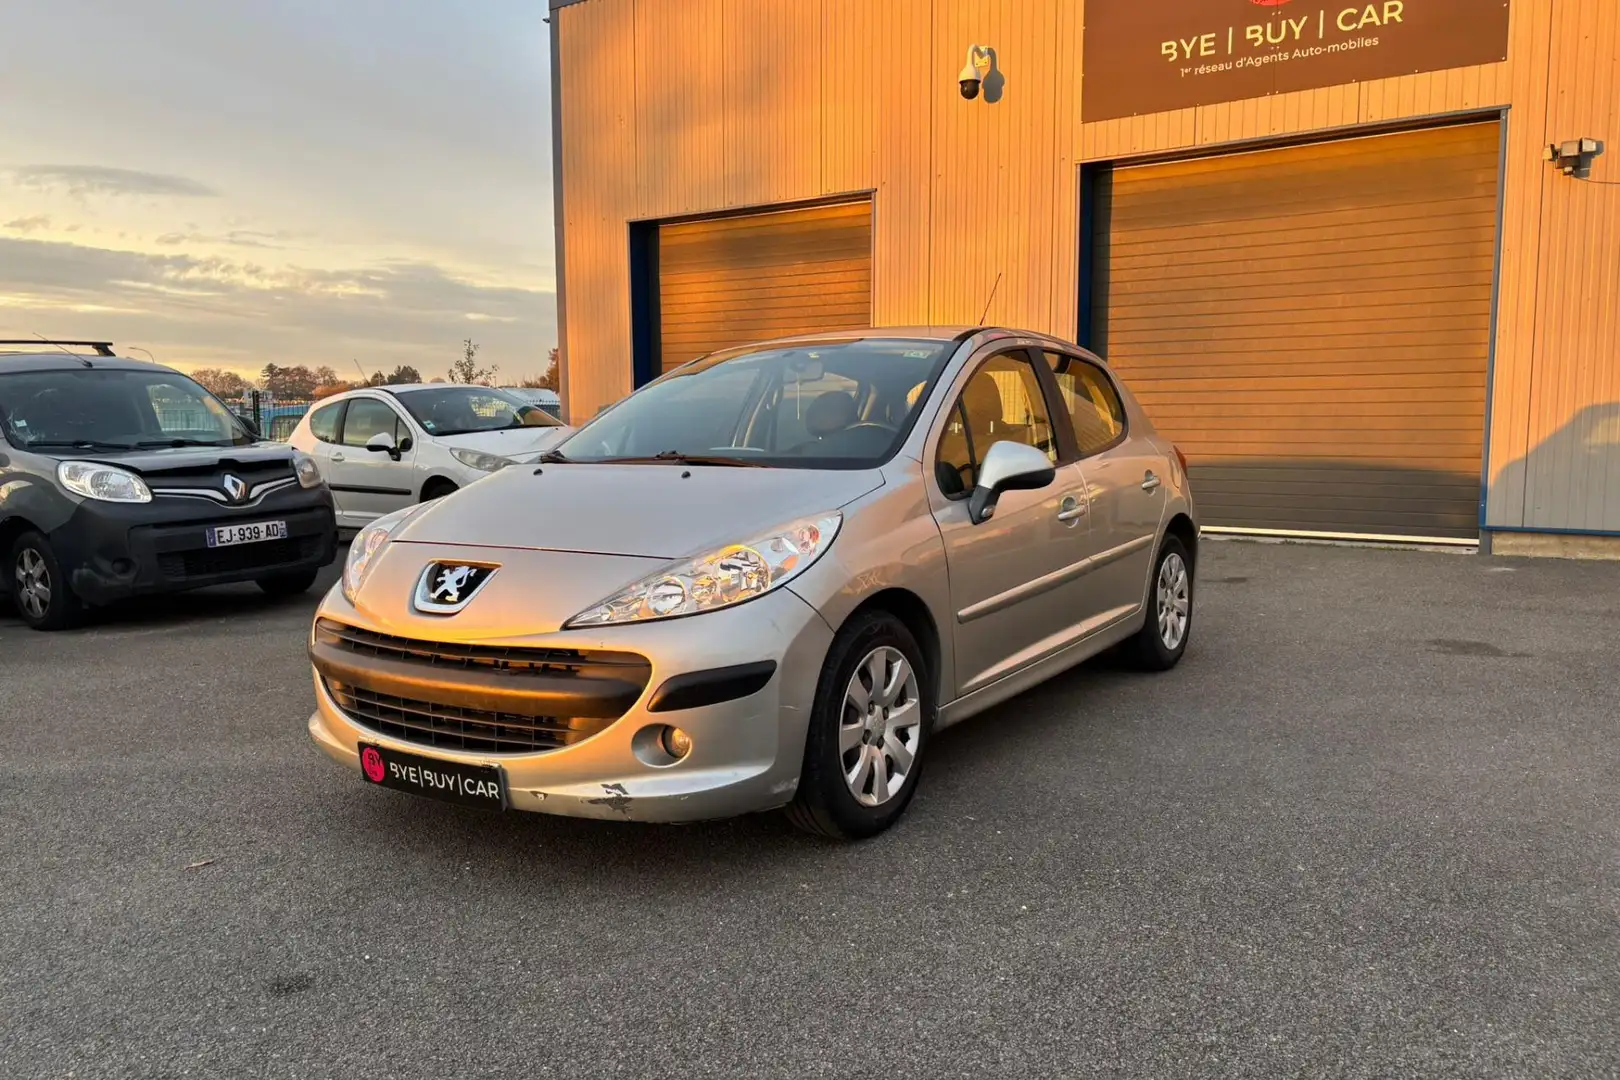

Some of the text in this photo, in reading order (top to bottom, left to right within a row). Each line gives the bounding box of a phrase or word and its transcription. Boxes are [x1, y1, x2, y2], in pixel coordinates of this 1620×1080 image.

[1161, 32, 1216, 62] BYE
[1246, 15, 1308, 47] BUY
[1336, 0, 1404, 31] CAR
[1180, 37, 1379, 77] 1er réseau d'Agents Auto-mobiles
